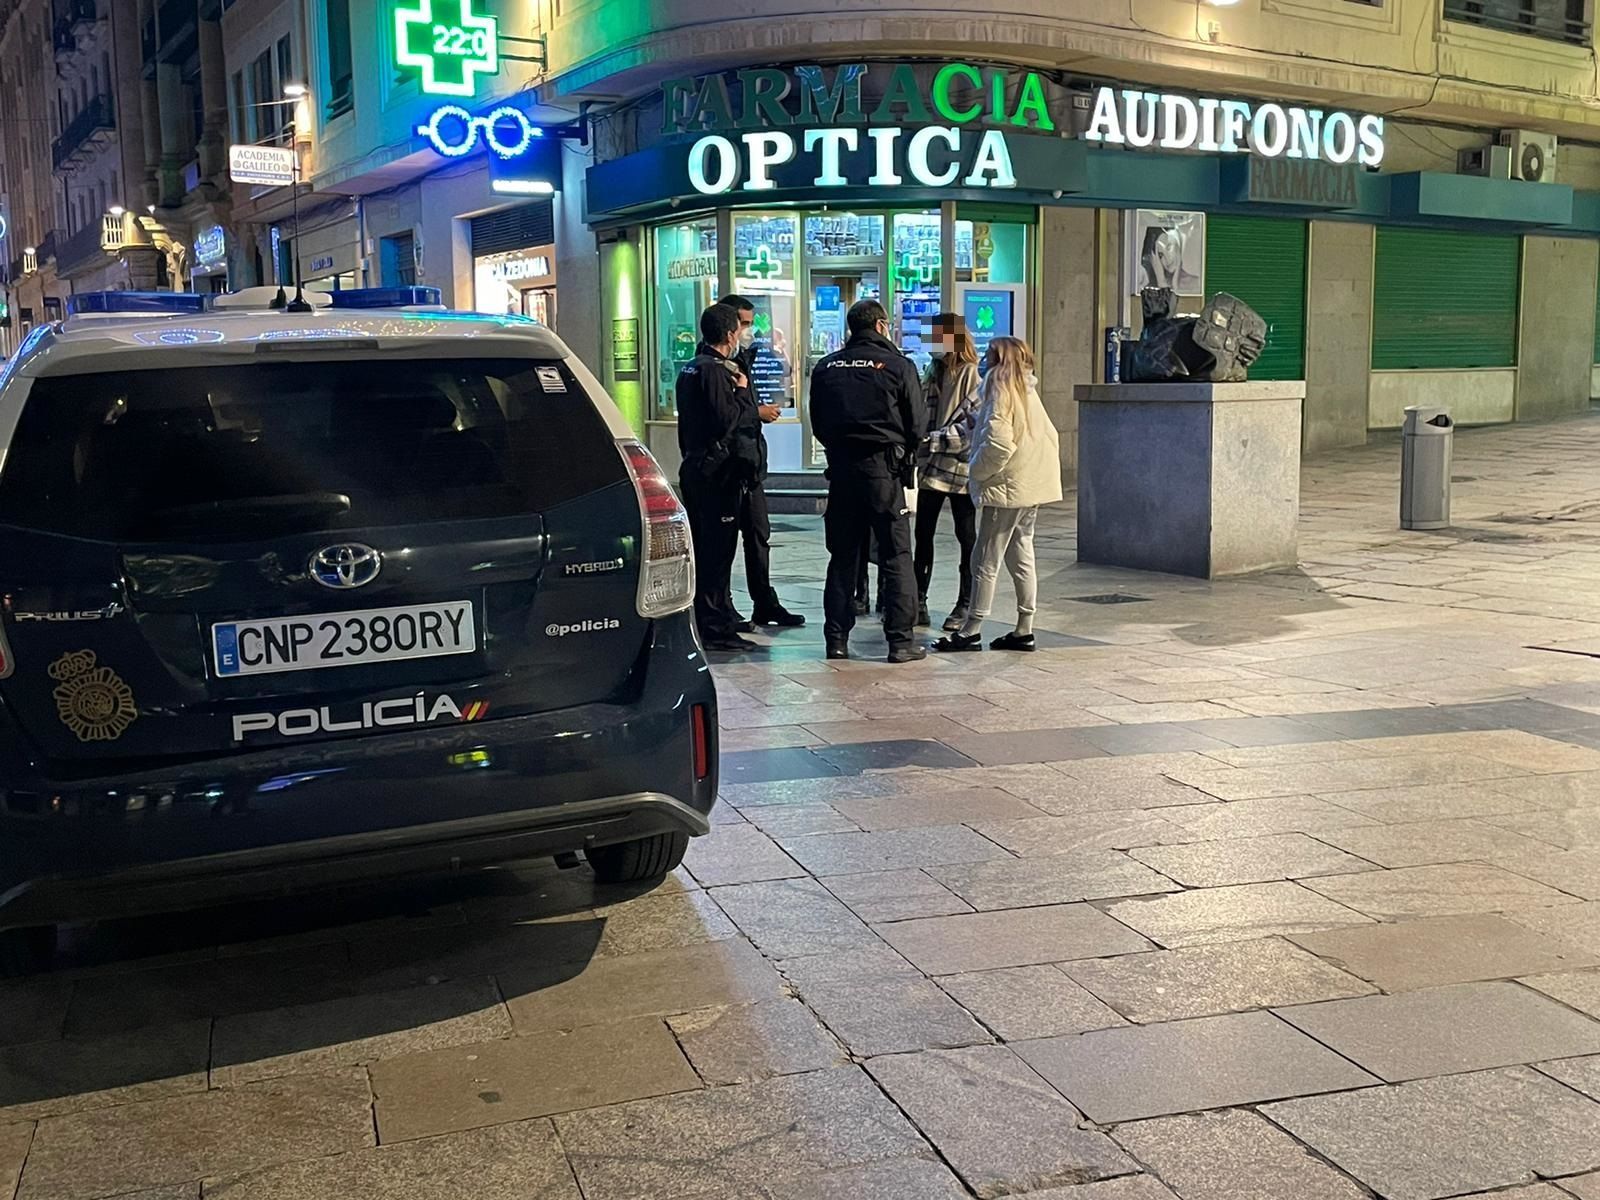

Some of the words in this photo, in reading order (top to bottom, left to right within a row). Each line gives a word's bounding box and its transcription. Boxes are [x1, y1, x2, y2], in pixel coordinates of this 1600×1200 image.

[660, 62, 1055, 135] FARMACIA
[1085, 86, 1385, 166] AUDIFONOS
[237, 150, 285, 162] ACADEMIA
[242, 161, 281, 172] GALILEO
[687, 125, 1018, 194] OPTICA
[1250, 158, 1357, 205] FARMACIA
[826, 359, 875, 369] POLICIA
[545, 618, 620, 636] @policia
[222, 653, 234, 666] E
[232, 690, 462, 741] POLICÍA
